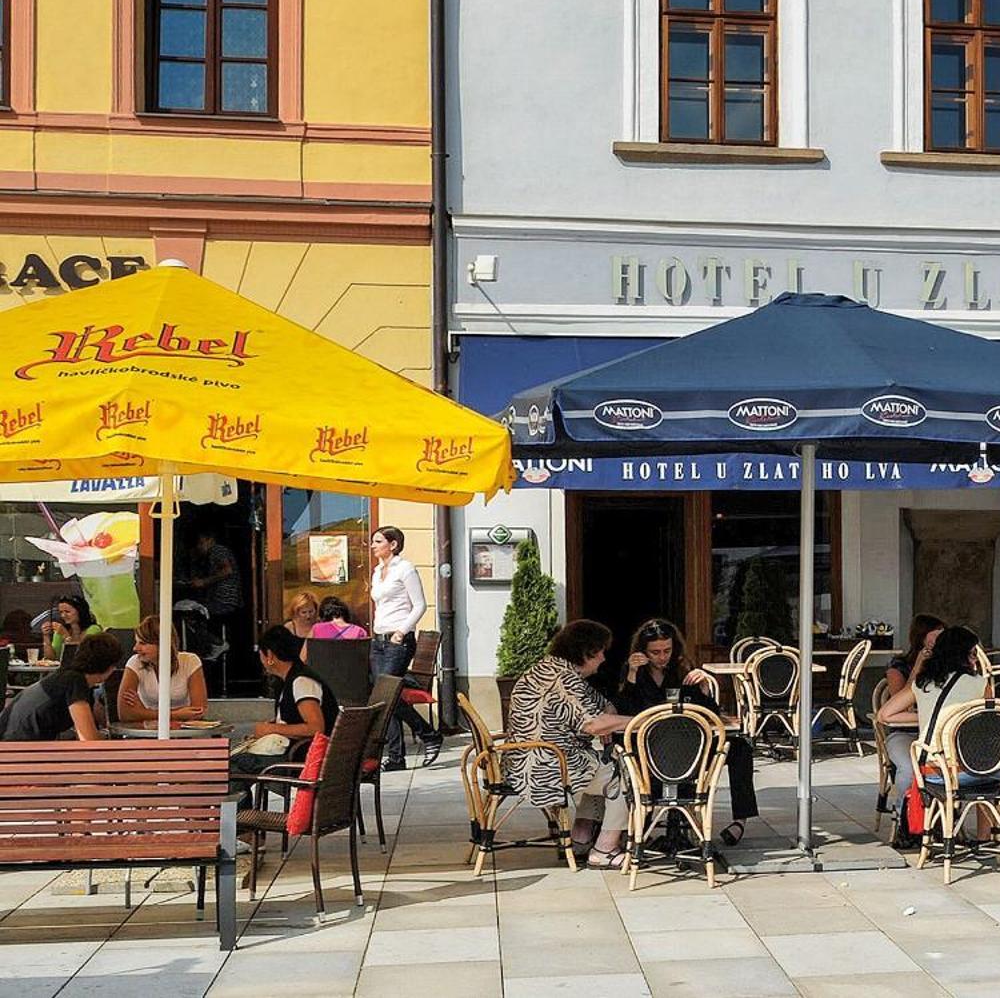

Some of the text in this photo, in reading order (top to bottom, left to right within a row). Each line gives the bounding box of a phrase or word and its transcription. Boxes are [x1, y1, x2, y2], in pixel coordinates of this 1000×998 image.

[0, 253, 146, 289] ACE
[610, 255, 804, 306] HOTEL
[852, 259, 882, 308] U
[44, 322, 258, 365] Rebel
[203, 378, 242, 390] pivo
[99, 399, 152, 430] Rebel
[602, 405, 654, 418] MATTONI
[735, 405, 789, 417] MATTONI
[869, 401, 919, 415] MATTONI
[207, 413, 262, 442] Rebel
[315, 425, 369, 456] Rebel
[422, 436, 475, 465] Rebel
[70, 476, 145, 493] LAVAZZA
[622, 462, 901, 480] HOTEL U ZLATHO LVA
